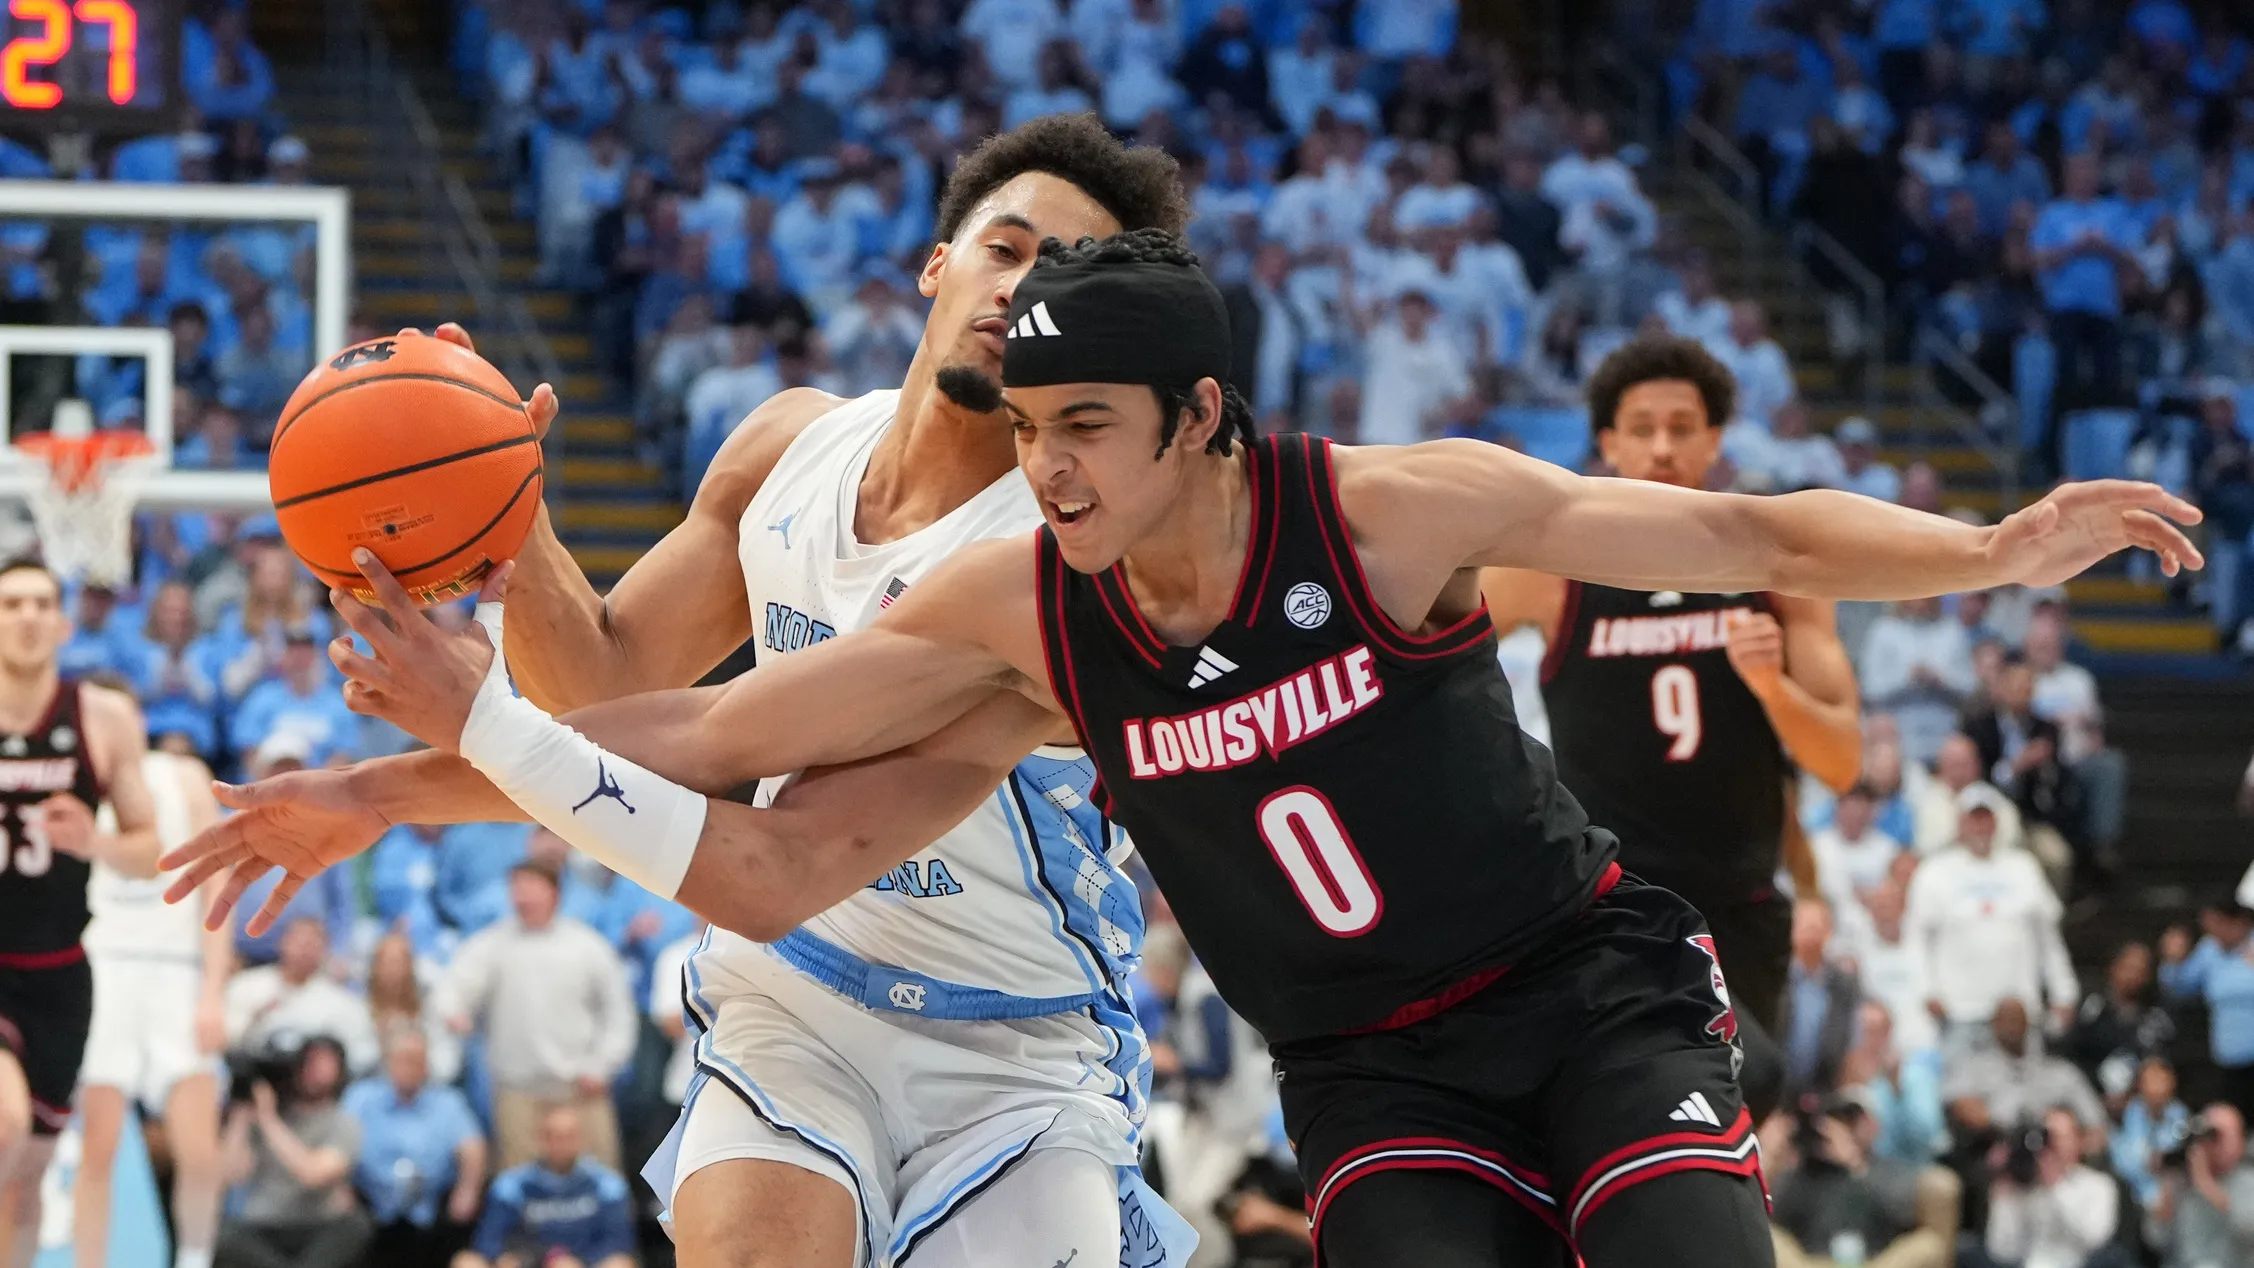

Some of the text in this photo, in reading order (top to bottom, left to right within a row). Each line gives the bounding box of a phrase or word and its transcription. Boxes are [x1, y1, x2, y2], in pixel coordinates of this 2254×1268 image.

[0, 0, 138, 109] 27
[1292, 593, 1326, 612] ACC
[1124, 643, 1383, 779] LOUISVILLE
[1652, 664, 1703, 762] 9
[0, 801, 53, 878] 3
[865, 859, 964, 898] INA
[1256, 785, 1384, 938] 0
